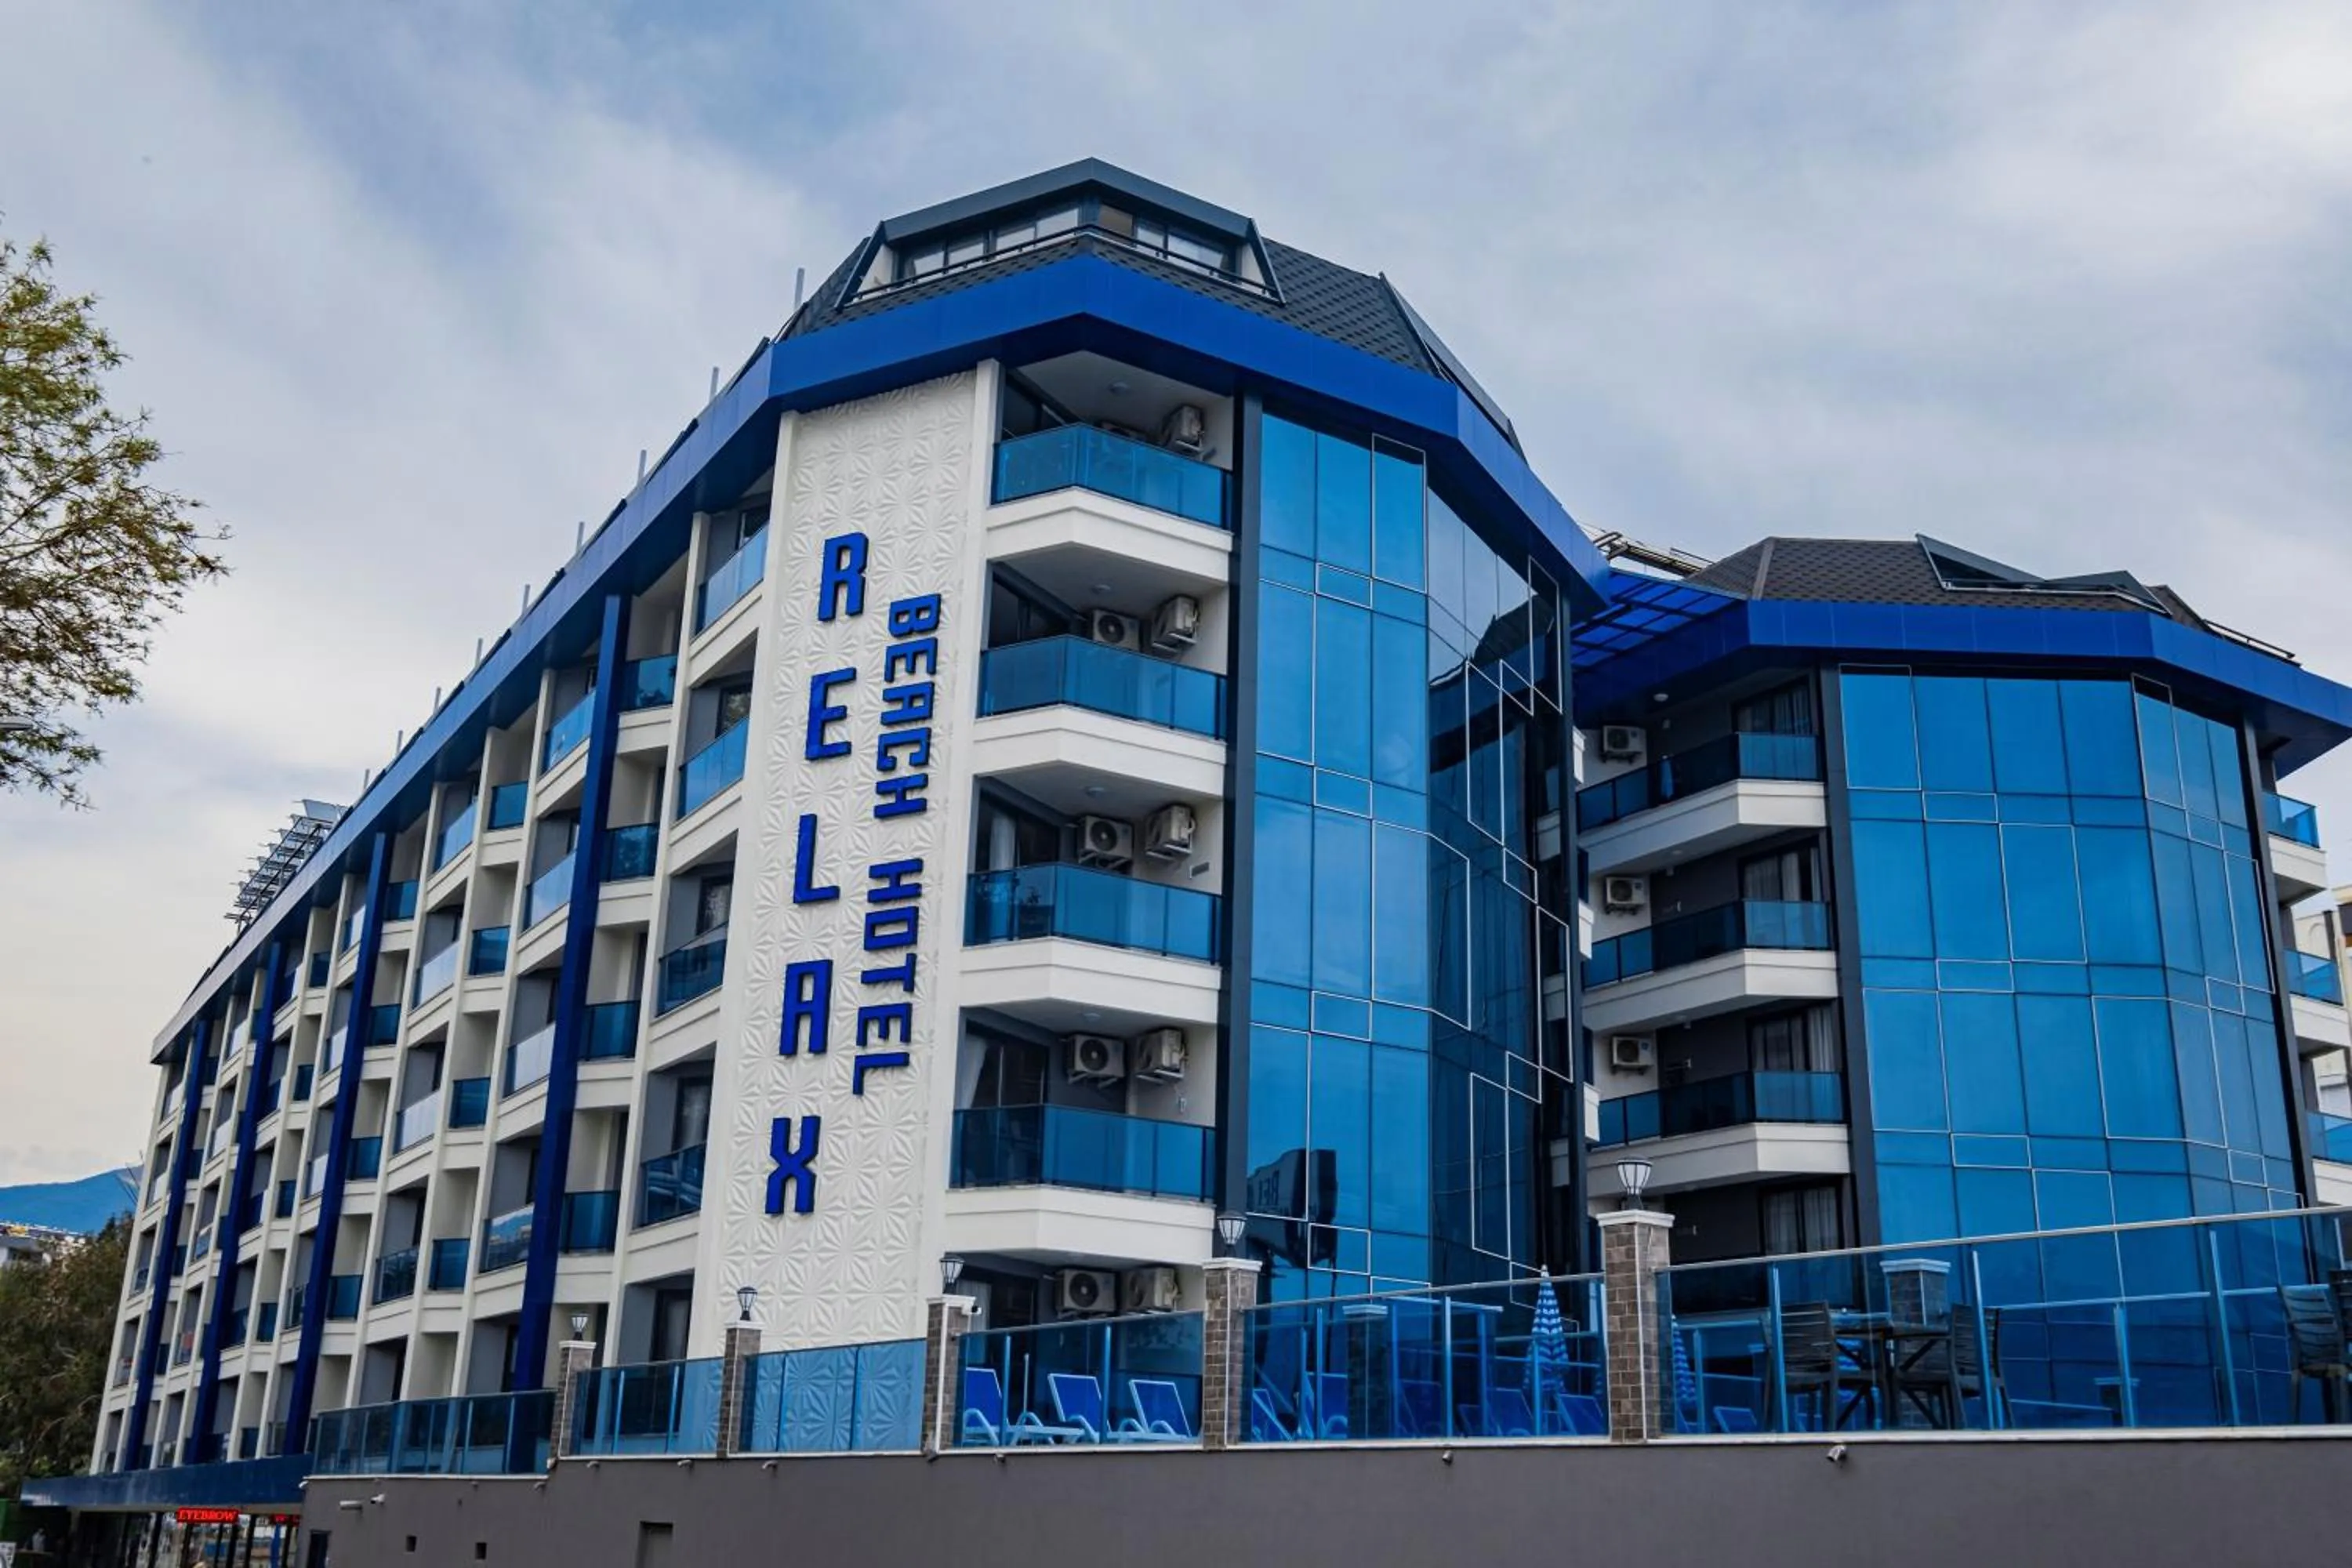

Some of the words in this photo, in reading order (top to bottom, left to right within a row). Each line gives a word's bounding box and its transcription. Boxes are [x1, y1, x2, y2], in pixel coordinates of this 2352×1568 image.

[873, 593, 941, 819] BEACH
[764, 532, 869, 1215] RELAX
[852, 858, 924, 1094] HOTEL
[177, 1509, 237, 1521] EYEBROW
